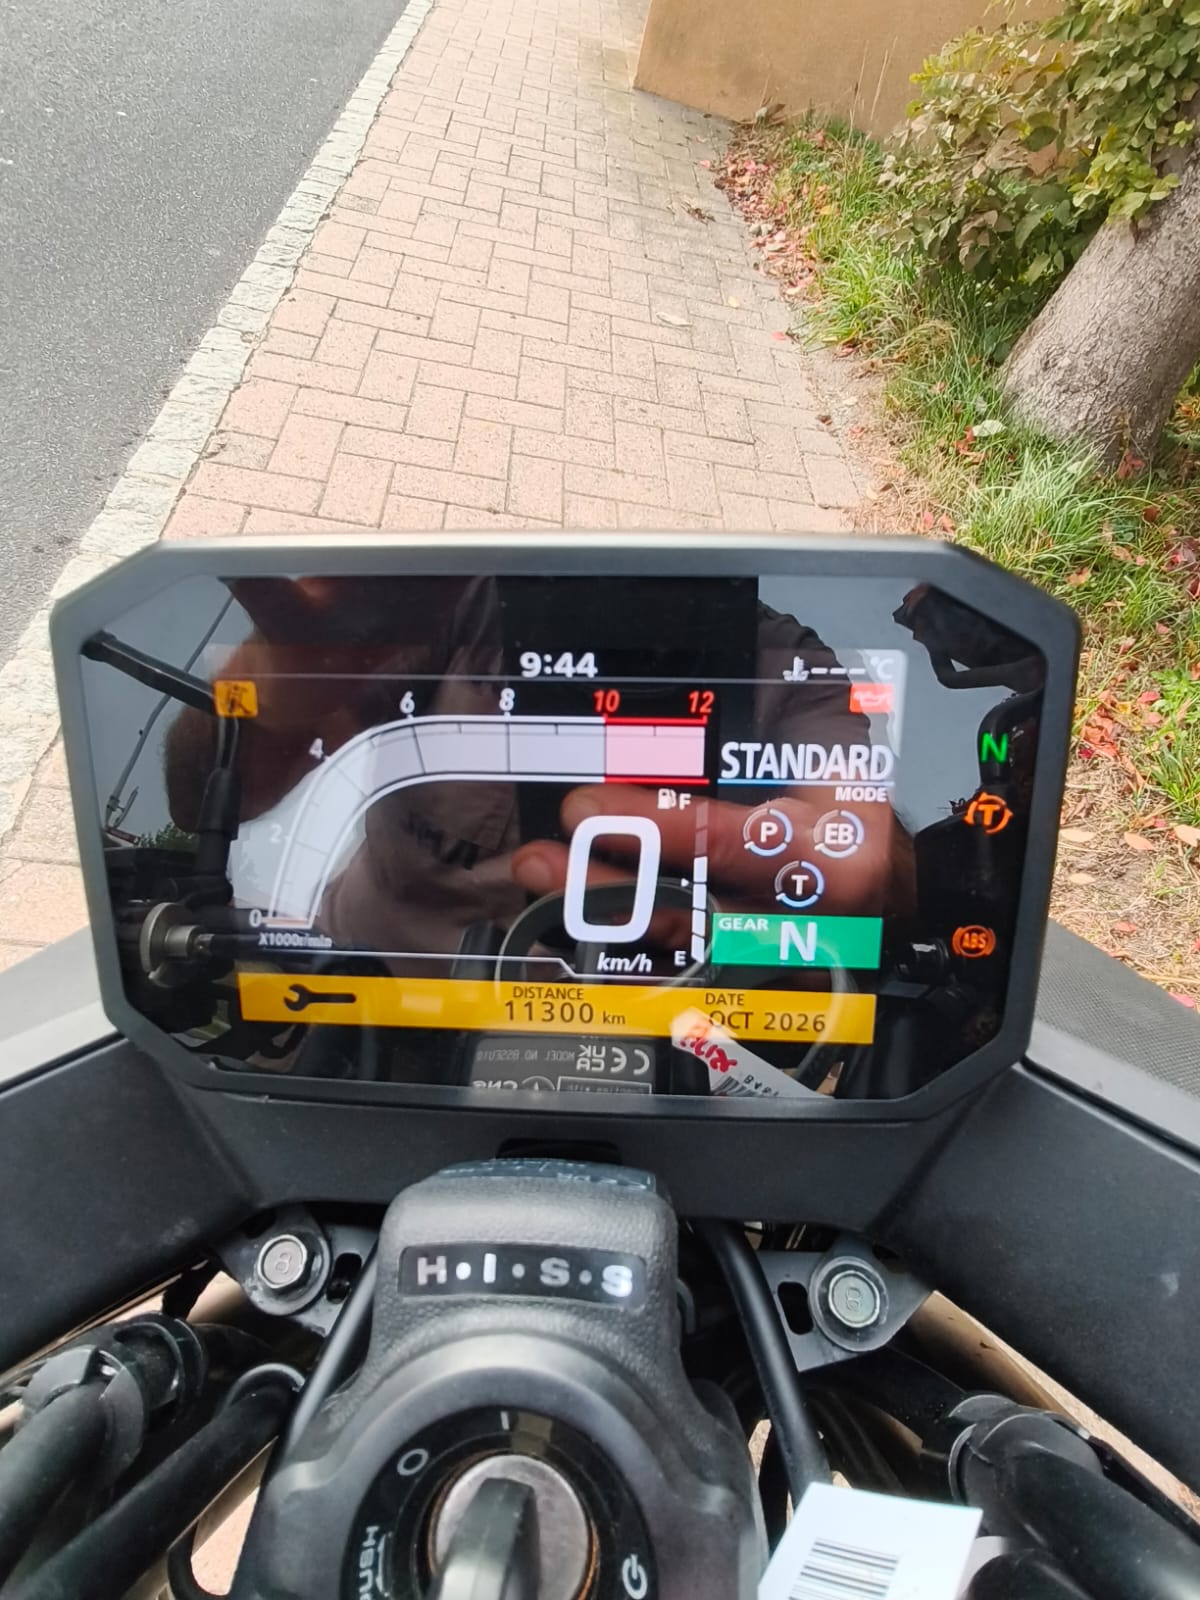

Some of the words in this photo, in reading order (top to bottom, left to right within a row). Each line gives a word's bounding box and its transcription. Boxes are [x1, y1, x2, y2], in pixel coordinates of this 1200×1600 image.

[519, 652, 598, 678] 9:44
[400, 692, 415, 713] 6
[500, 688, 515, 711] 8
[593, 689, 620, 712] 10
[688, 691, 714, 713] 12
[308, 738, 324, 757] 4
[981, 733, 1008, 763] N
[720, 742, 894, 780] STANDARD
[679, 793, 692, 810] F
[835, 787, 888, 802] MODE
[977, 804, 999, 826] T
[269, 824, 283, 843] 2
[760, 822, 778, 843] P
[824, 823, 855, 844] EB
[563, 815, 661, 943] 0
[791, 875, 809, 896] T
[249, 910, 262, 927] 0
[718, 917, 769, 931] GEAR
[779, 921, 818, 962] N
[961, 932, 988, 950] ABS
[597, 952, 653, 972] km/h
[674, 951, 687, 966] E
[512, 986, 585, 1001] DISTANCE
[705, 993, 745, 1006] DATE
[504, 1000, 594, 1024] 11300
[602, 1010, 626, 1025] km
[708, 1010, 754, 1030] OCT
[763, 1013, 827, 1033] 2026
